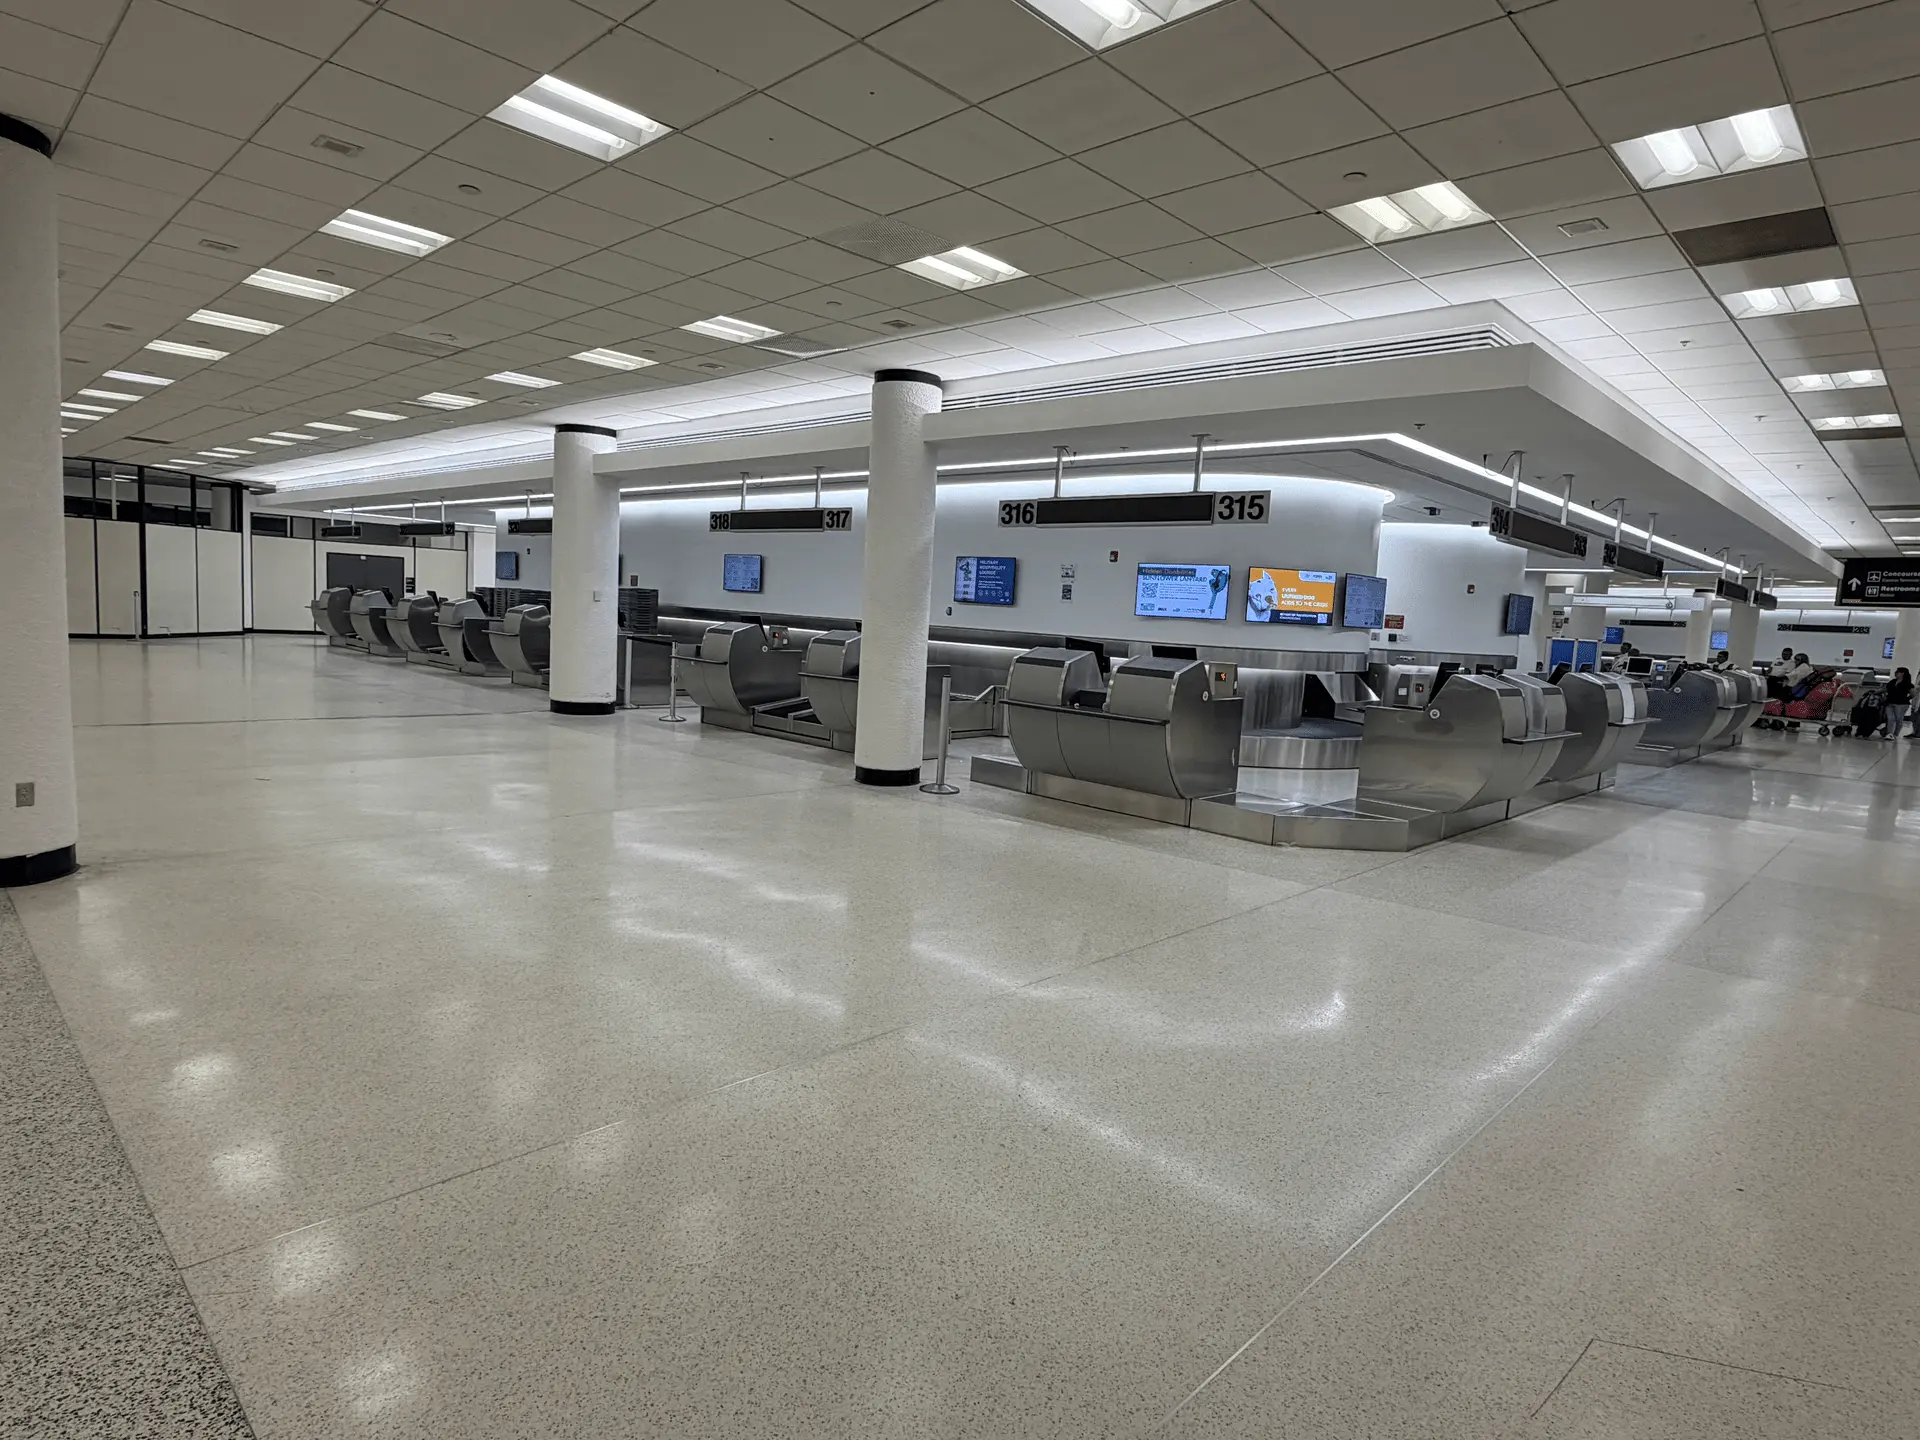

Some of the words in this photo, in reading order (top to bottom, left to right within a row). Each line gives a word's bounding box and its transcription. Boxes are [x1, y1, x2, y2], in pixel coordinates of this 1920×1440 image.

[1000, 503, 1035, 525] 316
[1217, 494, 1265, 521] 315
[710, 513, 730, 530] 318
[825, 510, 850, 528] 317
[1491, 506, 1511, 535] 314
